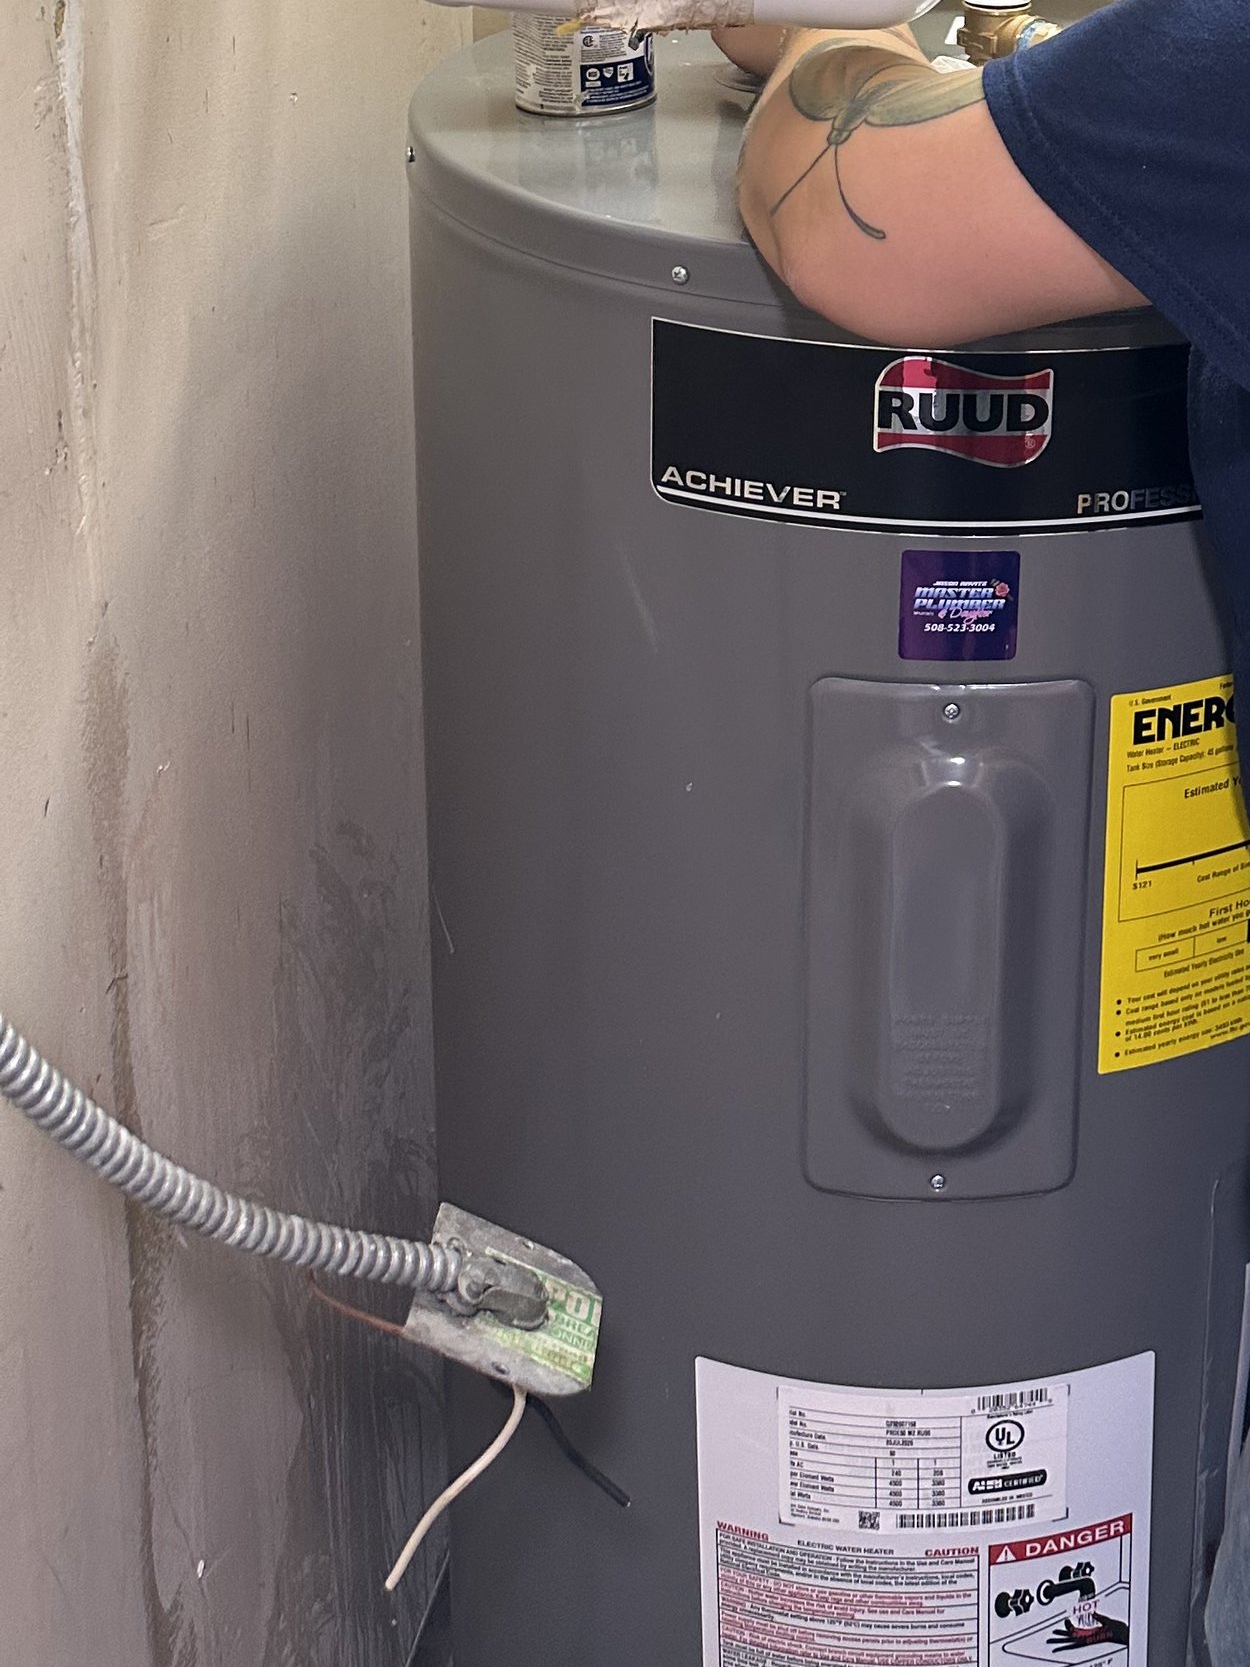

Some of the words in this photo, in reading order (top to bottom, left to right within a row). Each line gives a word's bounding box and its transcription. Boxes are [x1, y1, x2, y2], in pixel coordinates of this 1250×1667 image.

[877, 389, 1050, 433] RUUD
[914, 587, 994, 598] MASTER
[913, 599, 1006, 610] PLUMBER
[924, 624, 996, 632] 508-523-3004
[1173, 738, 1200, 750] ELECTRIC
[1127, 764, 1140, 772] Tank
[1184, 778, 1230, 799] Estimated
[1132, 880, 1152, 890] $121
[1209, 904, 1233, 918] First
[995, 1427, 1016, 1446] UL
[717, 1520, 769, 1542] WARNING
[1025, 1520, 1124, 1557] DANGER
[797, 1540, 834, 1551] ELECTRIC
[835, 1545, 862, 1553] WATER
[925, 1546, 979, 1557] CAUTION
[1073, 1599, 1100, 1614] HOT
